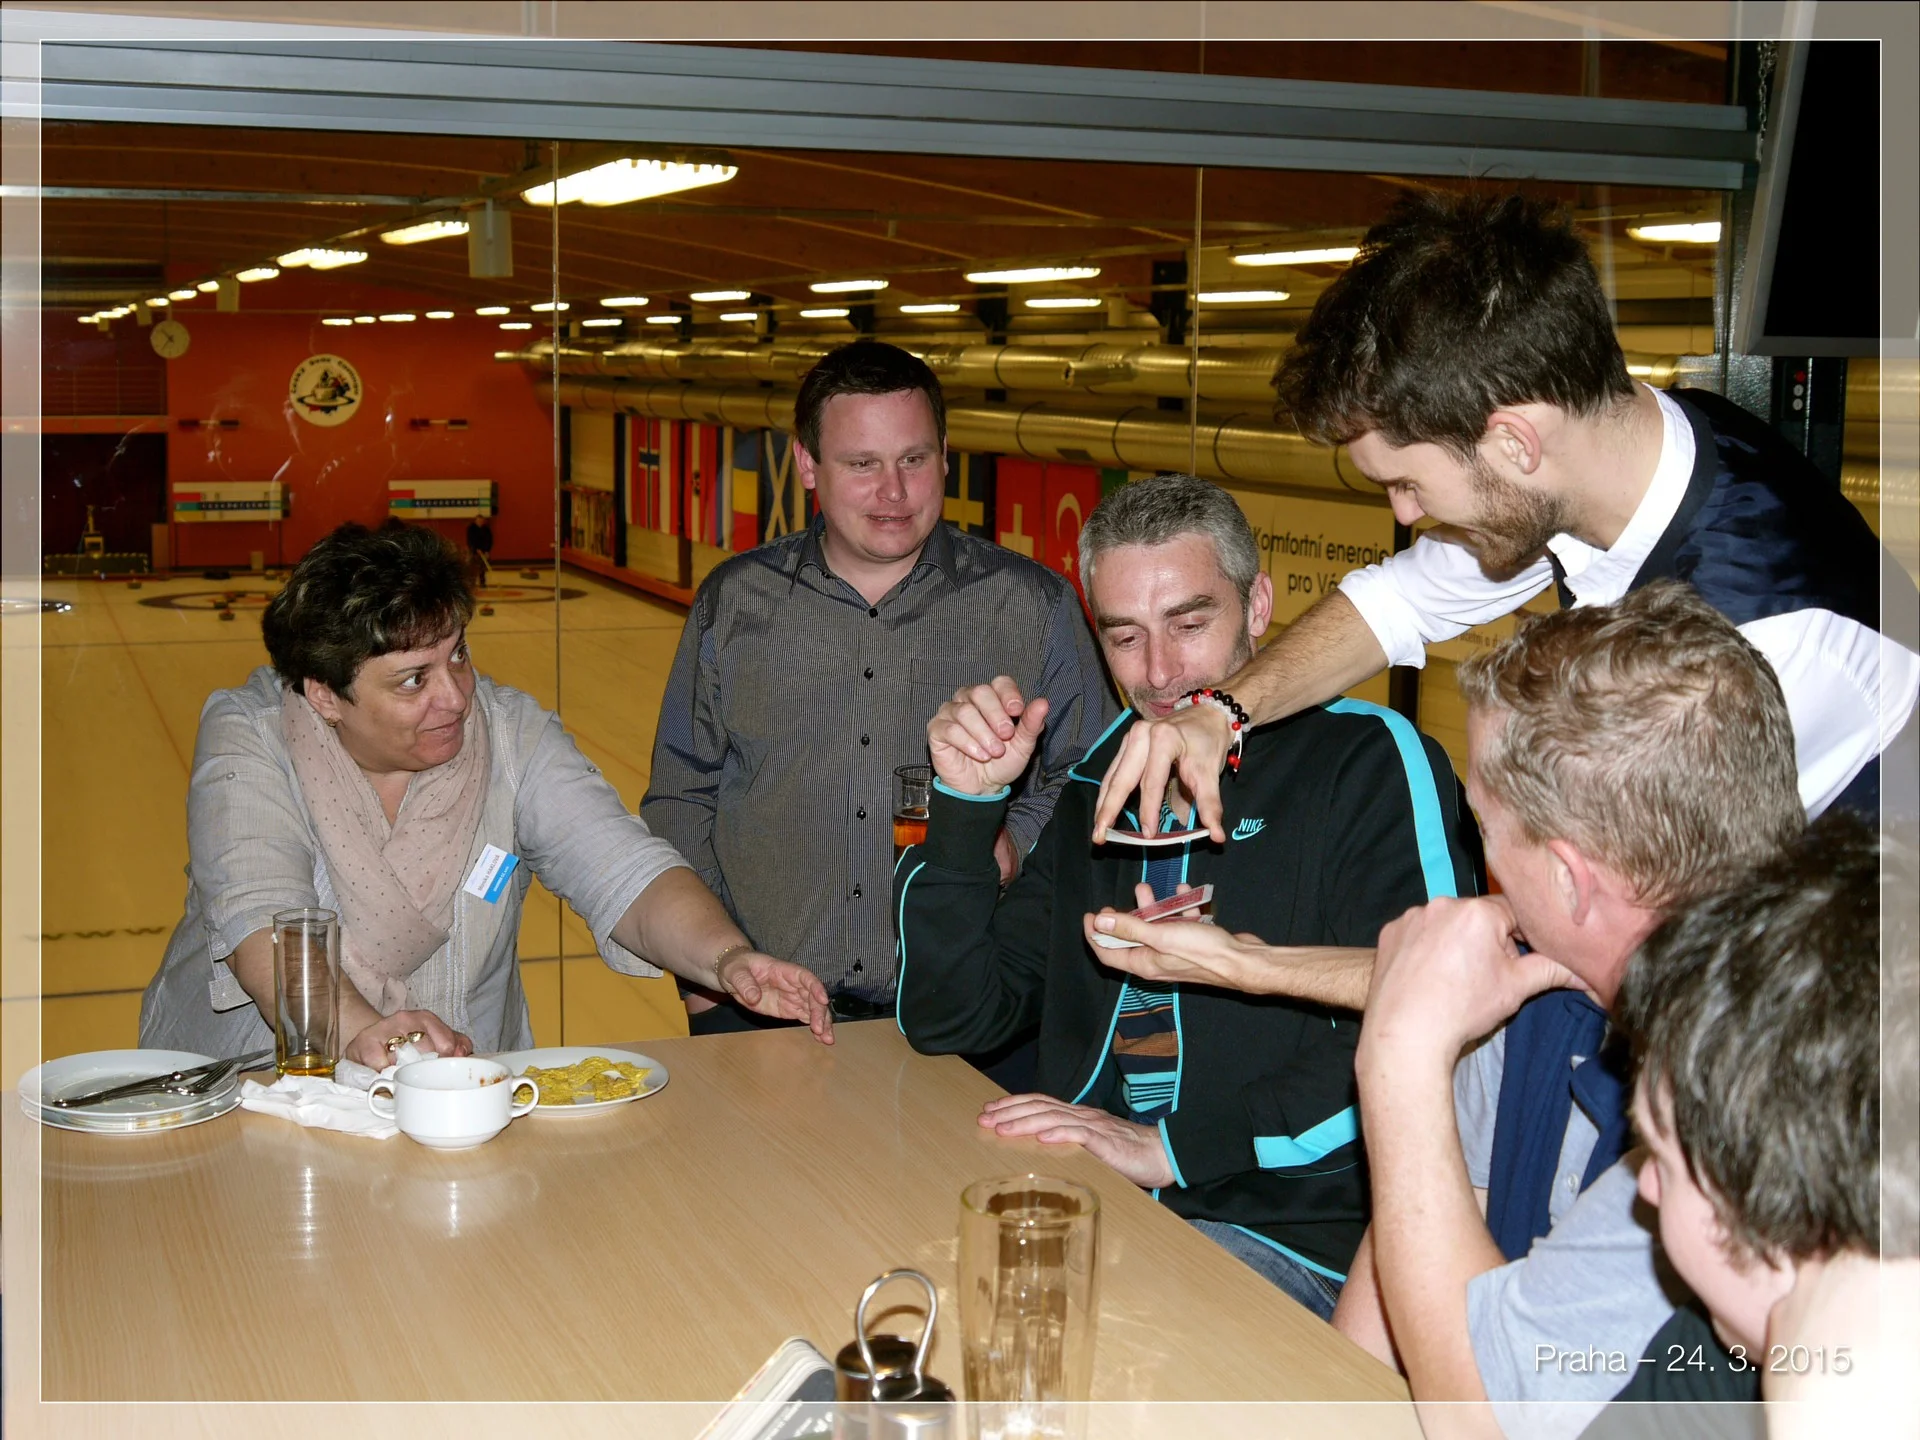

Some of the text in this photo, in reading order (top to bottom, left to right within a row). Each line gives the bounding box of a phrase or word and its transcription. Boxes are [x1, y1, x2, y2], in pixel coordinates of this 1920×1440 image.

[1253, 526, 1389, 566] Komfortní energie
[1288, 572, 1338, 596] pro Vá
[1238, 818, 1264, 832] NIKE
